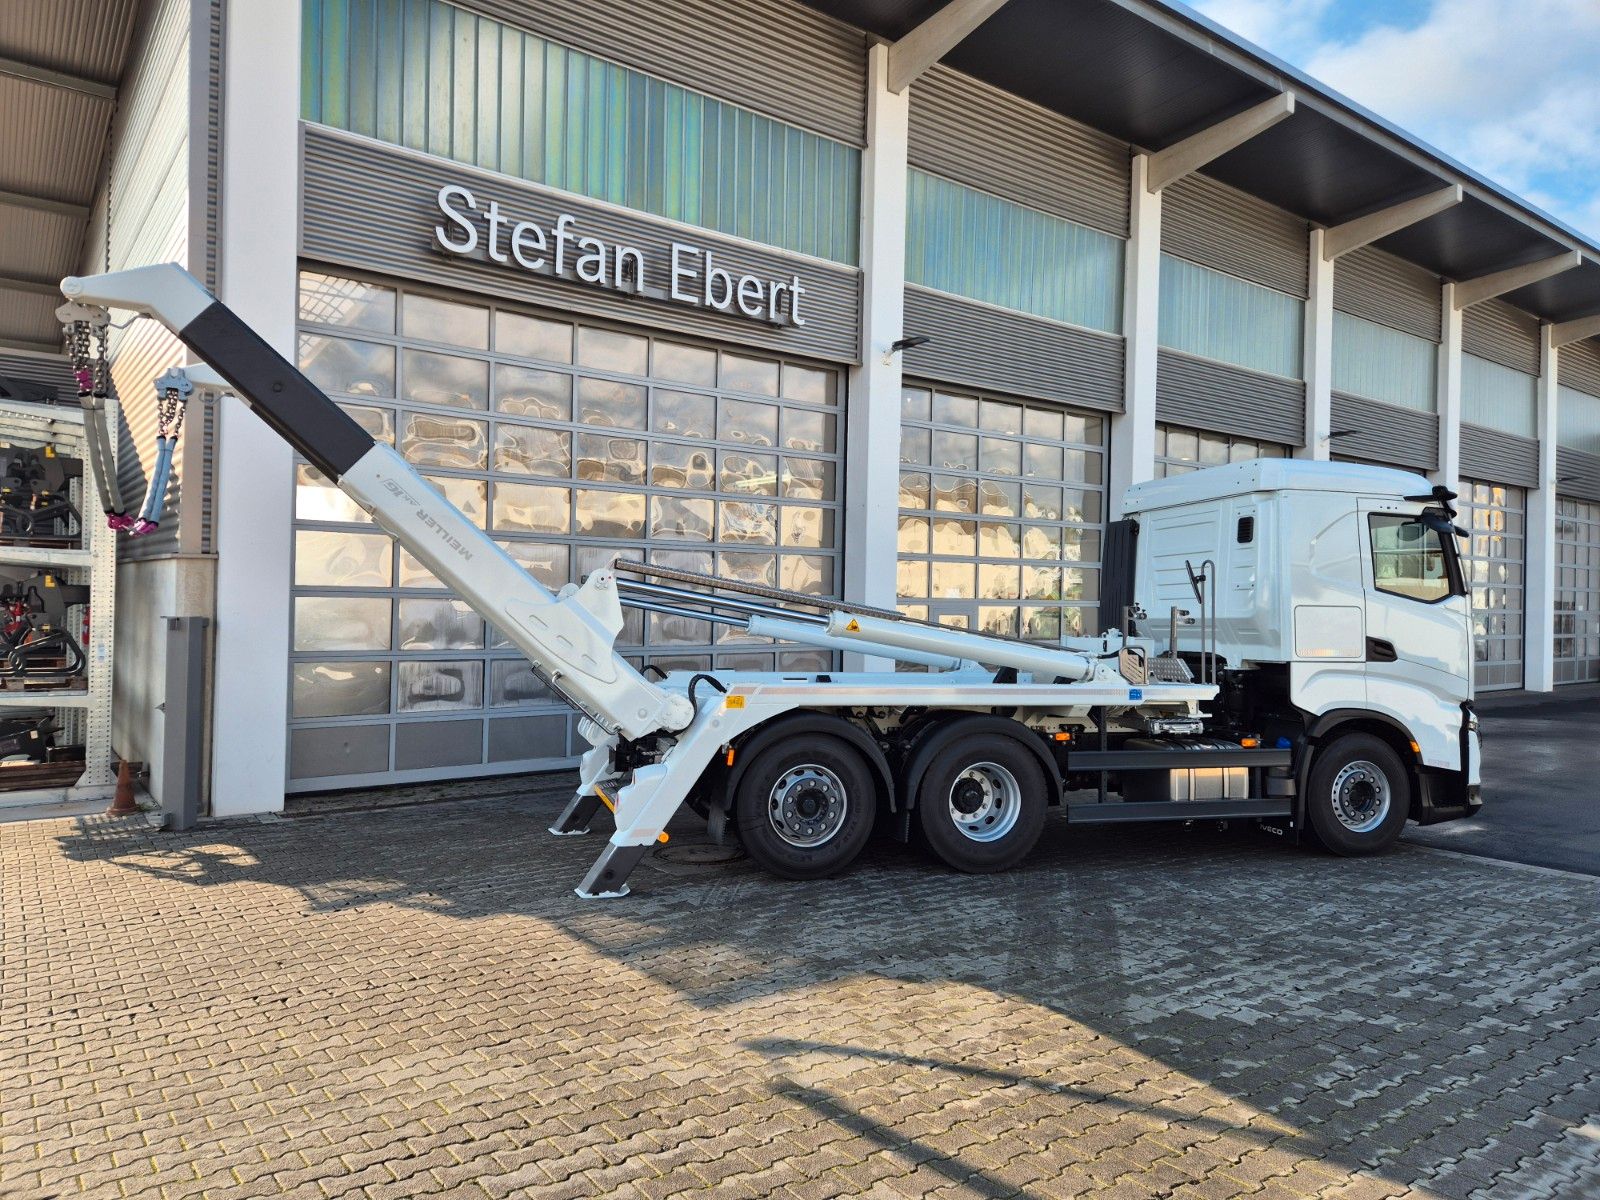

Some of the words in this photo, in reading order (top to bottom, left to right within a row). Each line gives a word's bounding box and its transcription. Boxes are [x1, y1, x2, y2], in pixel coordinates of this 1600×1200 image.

[435, 184, 644, 293] Stefan
[671, 242, 806, 326] Ebert
[416, 509, 473, 560] MEILLER
